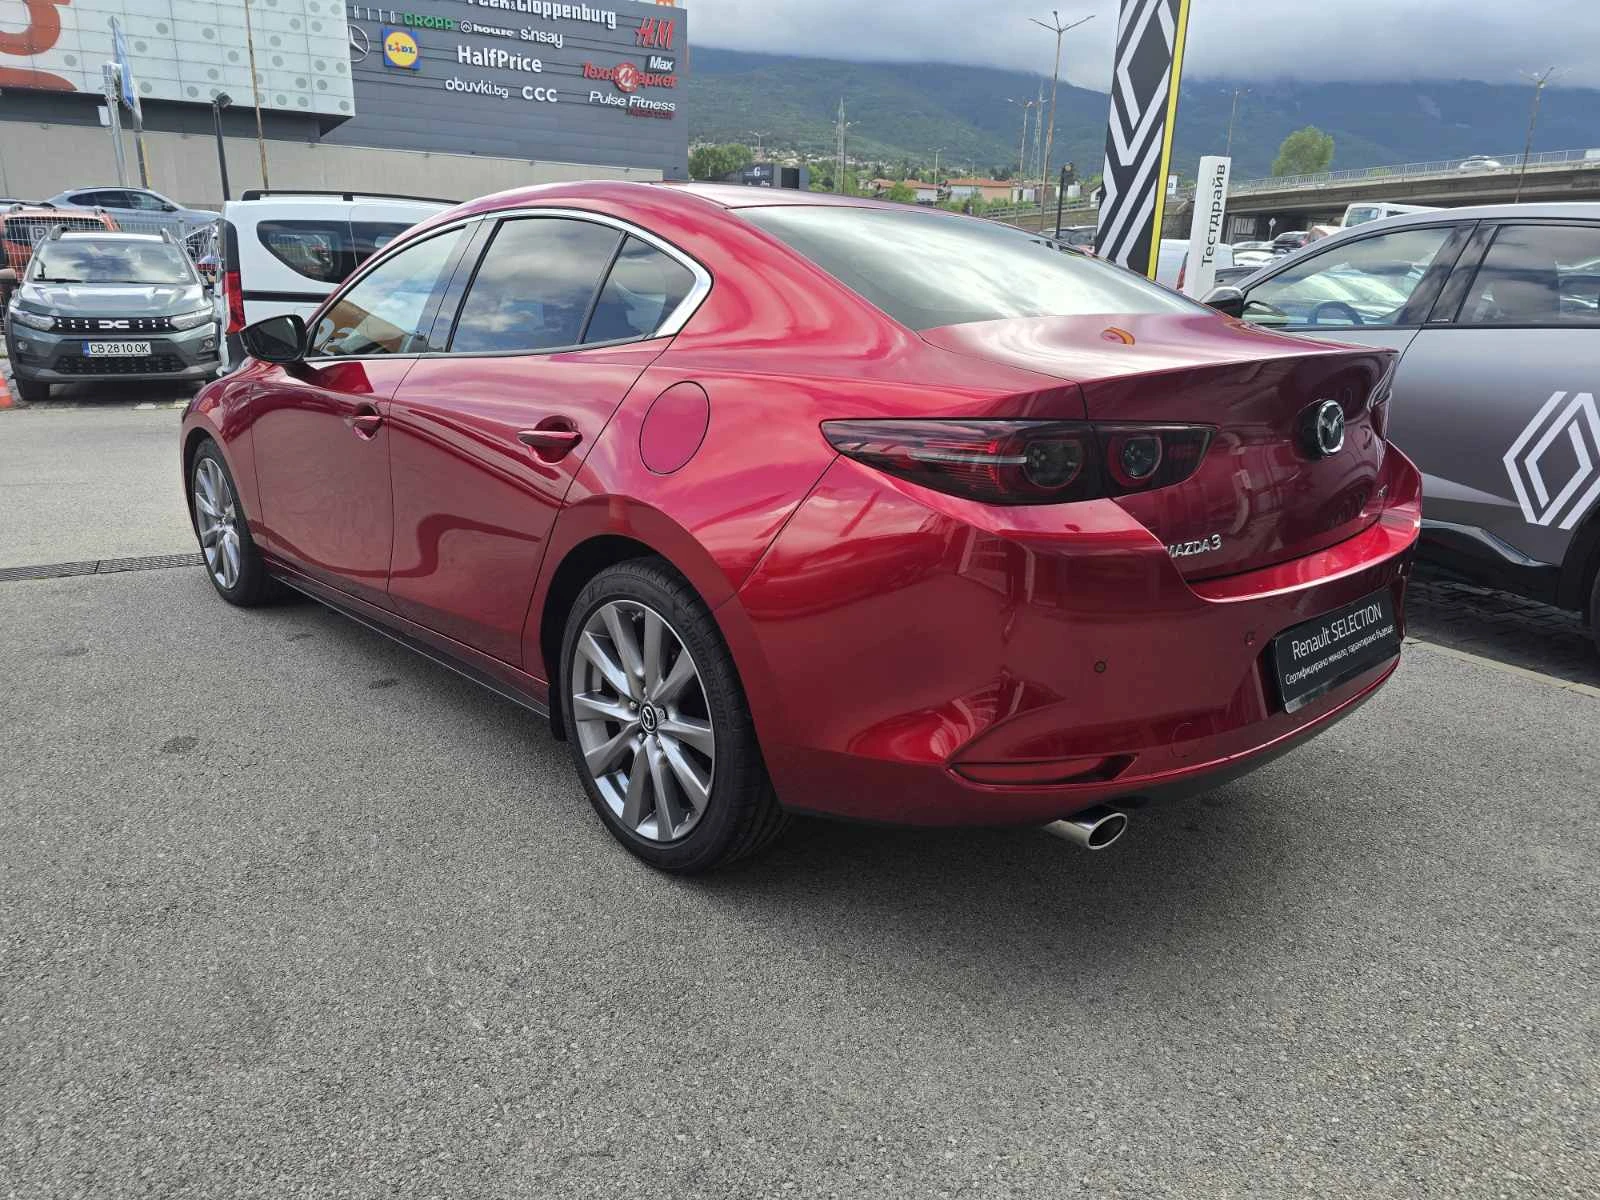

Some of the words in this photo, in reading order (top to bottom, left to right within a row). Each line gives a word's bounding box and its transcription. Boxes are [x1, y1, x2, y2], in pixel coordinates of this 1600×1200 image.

[520, 26, 564, 48] sinsay
[457, 45, 543, 73] HalfPrice
[649, 56, 673, 71] Max
[445, 77, 509, 98] obuvki.bg
[521, 86, 558, 102] CCC
[589, 90, 626, 106] Pulse
[628, 95, 676, 111] Fitness
[1202, 164, 1226, 268] Тестдрайв
[1292, 626, 1332, 661] Renault
[1331, 602, 1382, 642] SELECTION
